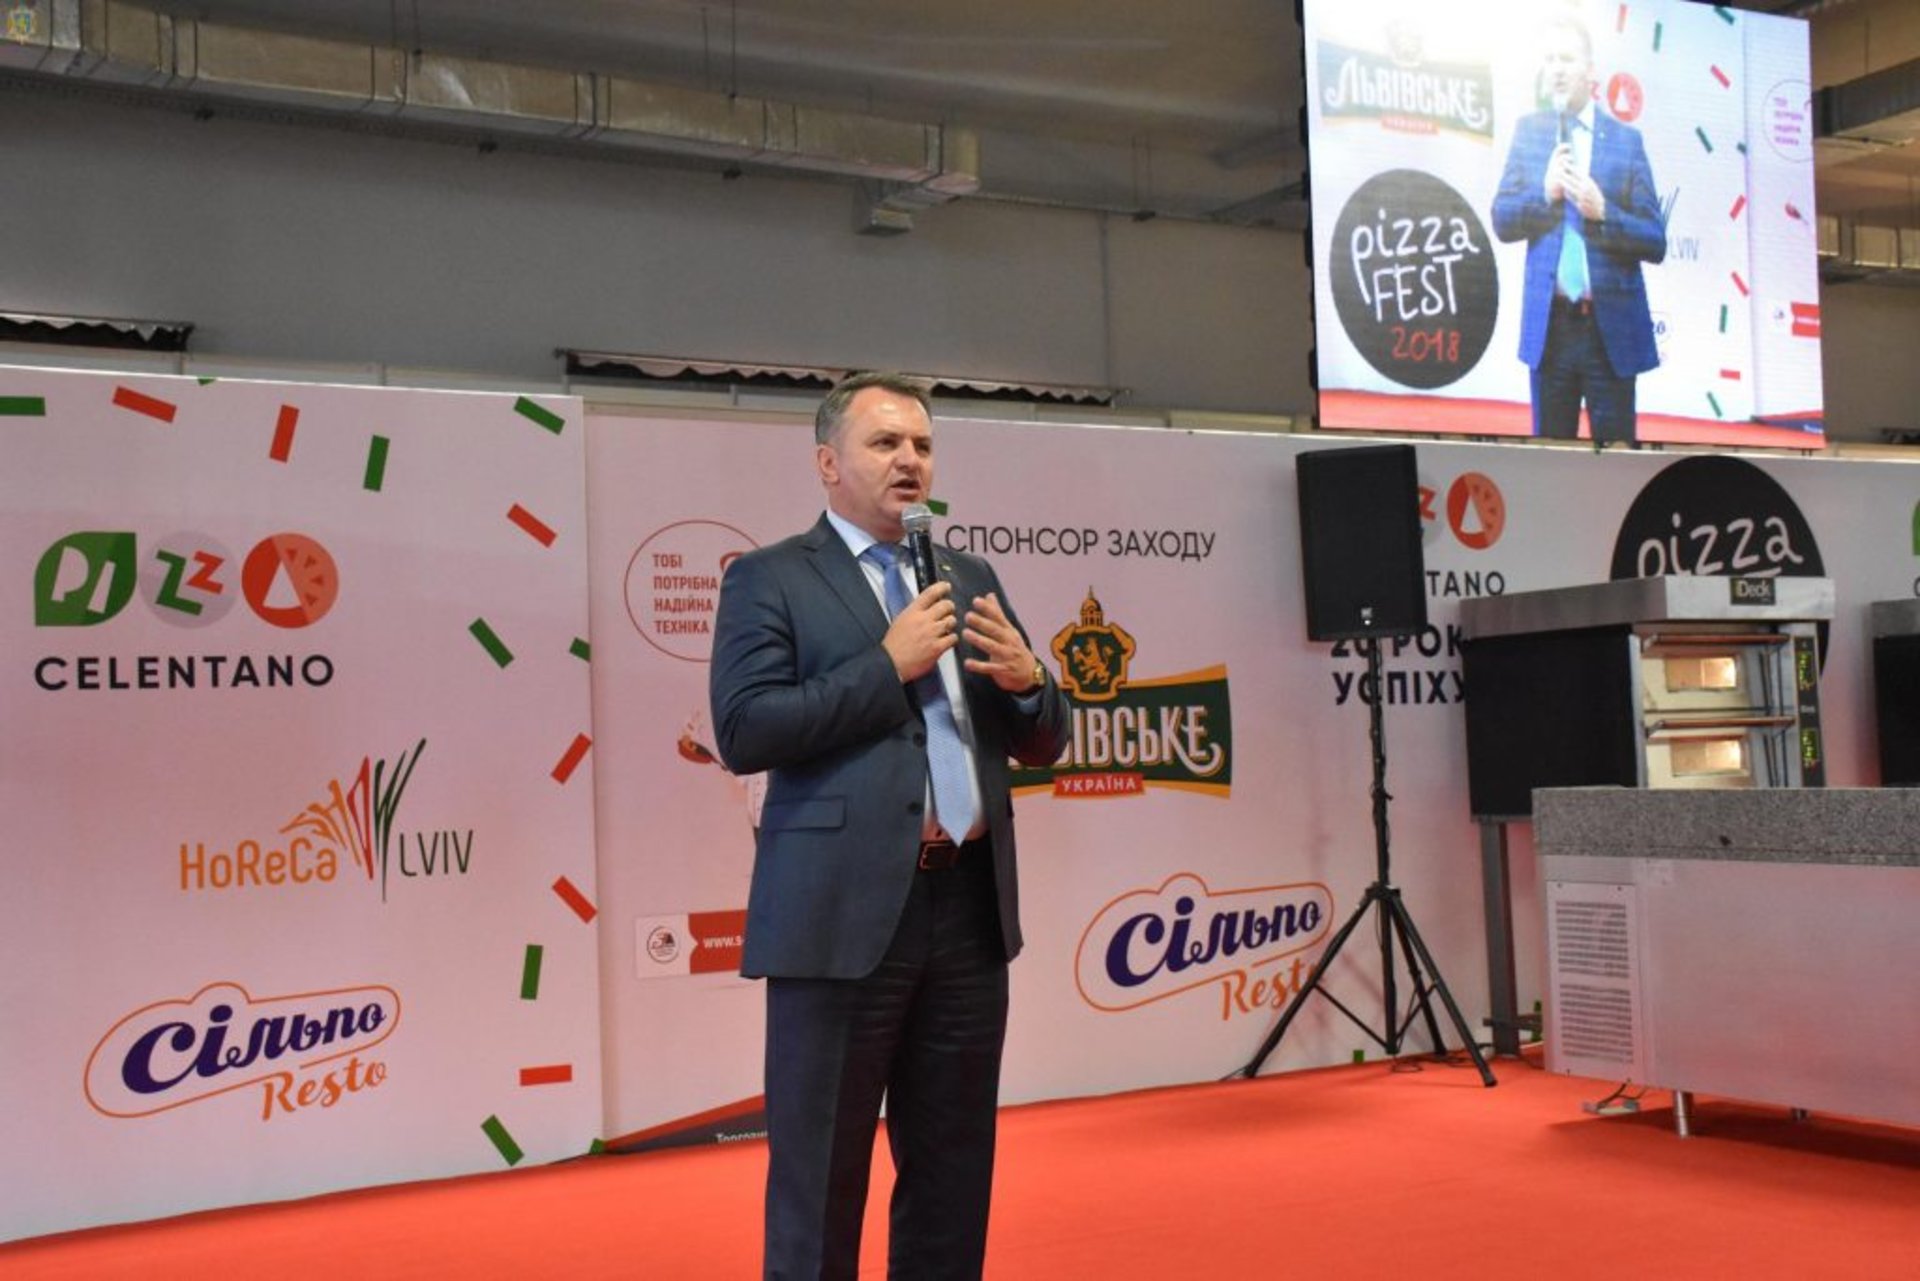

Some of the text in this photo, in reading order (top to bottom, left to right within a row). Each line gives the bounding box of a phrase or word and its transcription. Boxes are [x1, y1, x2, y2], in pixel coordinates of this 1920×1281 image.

[1351, 208, 1480, 304] pizza
[1373, 254, 1463, 322] FEST
[1390, 326, 1461, 363] 2018
[653, 554, 682, 568] ТОБІ
[945, 525, 1216, 561] СПОНСОР ЗАХОДУ
[653, 576, 718, 590] ПОТРІБНА
[653, 595, 714, 613] НАДІЙНА
[655, 620, 710, 634] ТЕХНІКА
[1391, 624, 1466, 658] РОК
[34, 654, 334, 691] CELENTANO
[1062, 775, 1137, 793] УКРАЇНА
[179, 840, 337, 890] HoReCa
[399, 829, 474, 877] LVIV
[1105, 896, 1322, 987] Сільпо
[1222, 957, 1319, 1021] Rest
[121, 1004, 387, 1095] Сільпо
[262, 1057, 388, 1121] Resto
